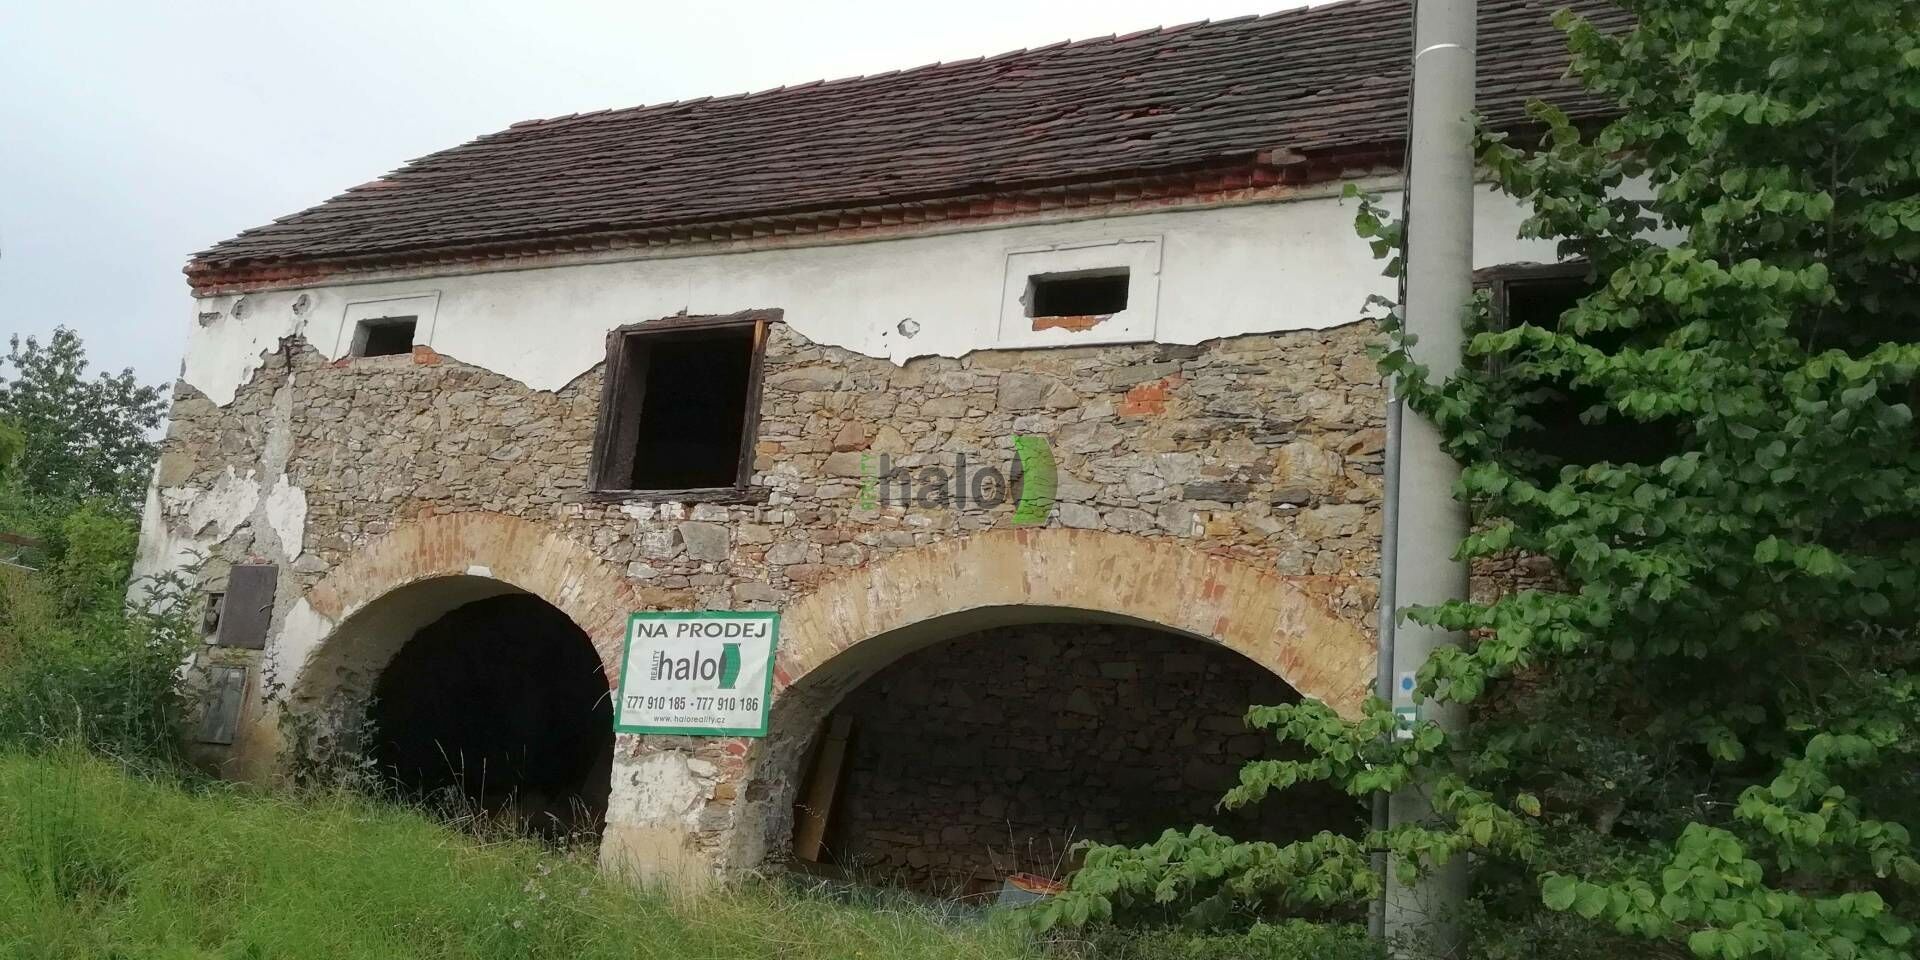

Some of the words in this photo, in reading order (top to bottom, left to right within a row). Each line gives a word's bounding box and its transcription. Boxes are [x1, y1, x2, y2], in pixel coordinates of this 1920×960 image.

[637, 623, 668, 638] NA
[676, 622, 767, 638] PRODEJ
[650, 650, 660, 681] REALITY
[657, 650, 717, 681] halo
[627, 695, 645, 709] 777
[647, 695, 665, 710] 910
[669, 696, 686, 710] 185
[696, 697, 714, 710] 777
[717, 697, 736, 711] 910
[740, 697, 759, 711] 186
